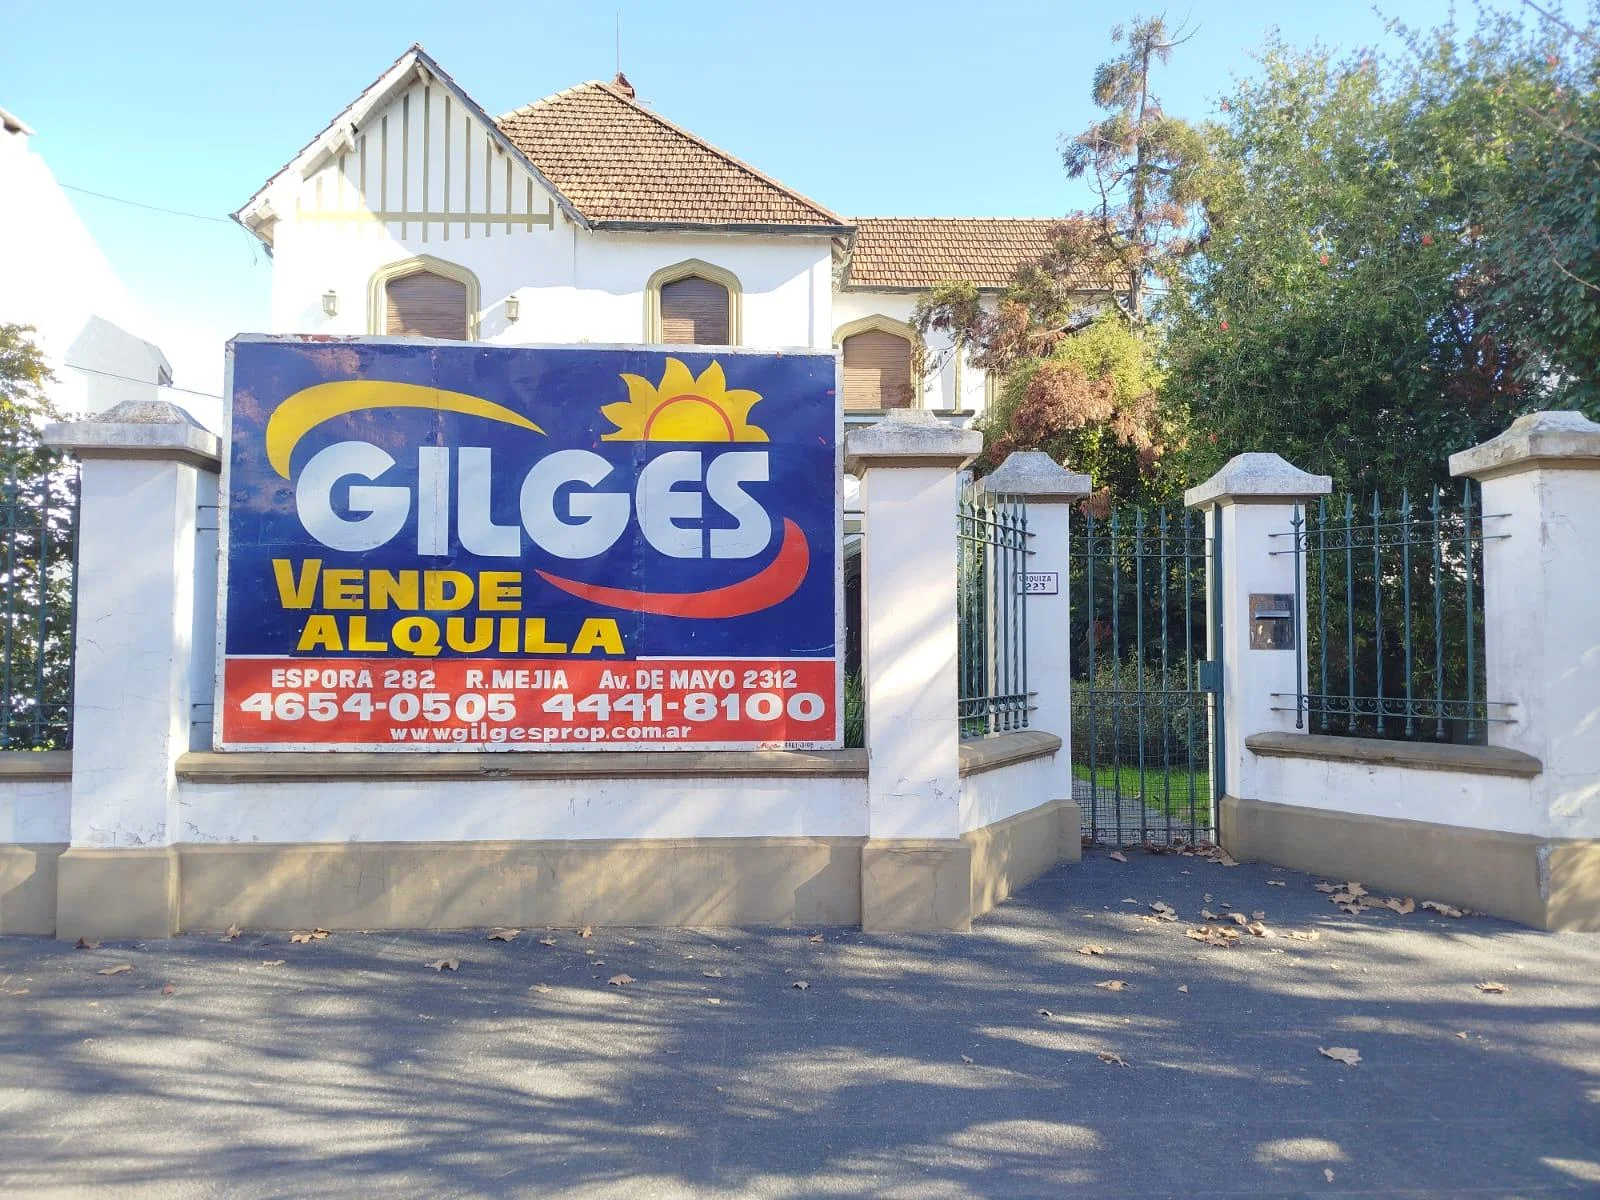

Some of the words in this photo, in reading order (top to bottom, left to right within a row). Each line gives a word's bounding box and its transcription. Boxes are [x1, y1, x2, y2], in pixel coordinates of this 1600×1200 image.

[296, 440, 773, 560] GILGES
[272, 558, 522, 611] VENDE
[1025, 582, 1046, 591] 223
[296, 615, 625, 656] ALQUILA
[271, 669, 373, 688] ESPORA
[384, 670, 436, 689] 282
[599, 670, 631, 690] Av.
[636, 670, 663, 690] DE
[670, 670, 735, 690] MAYO
[743, 670, 797, 689] 2312
[240, 692, 517, 722] 4654-0505
[542, 693, 825, 722] 4441-8100
[390, 722, 692, 742] www.gilgesprop.com.ar
